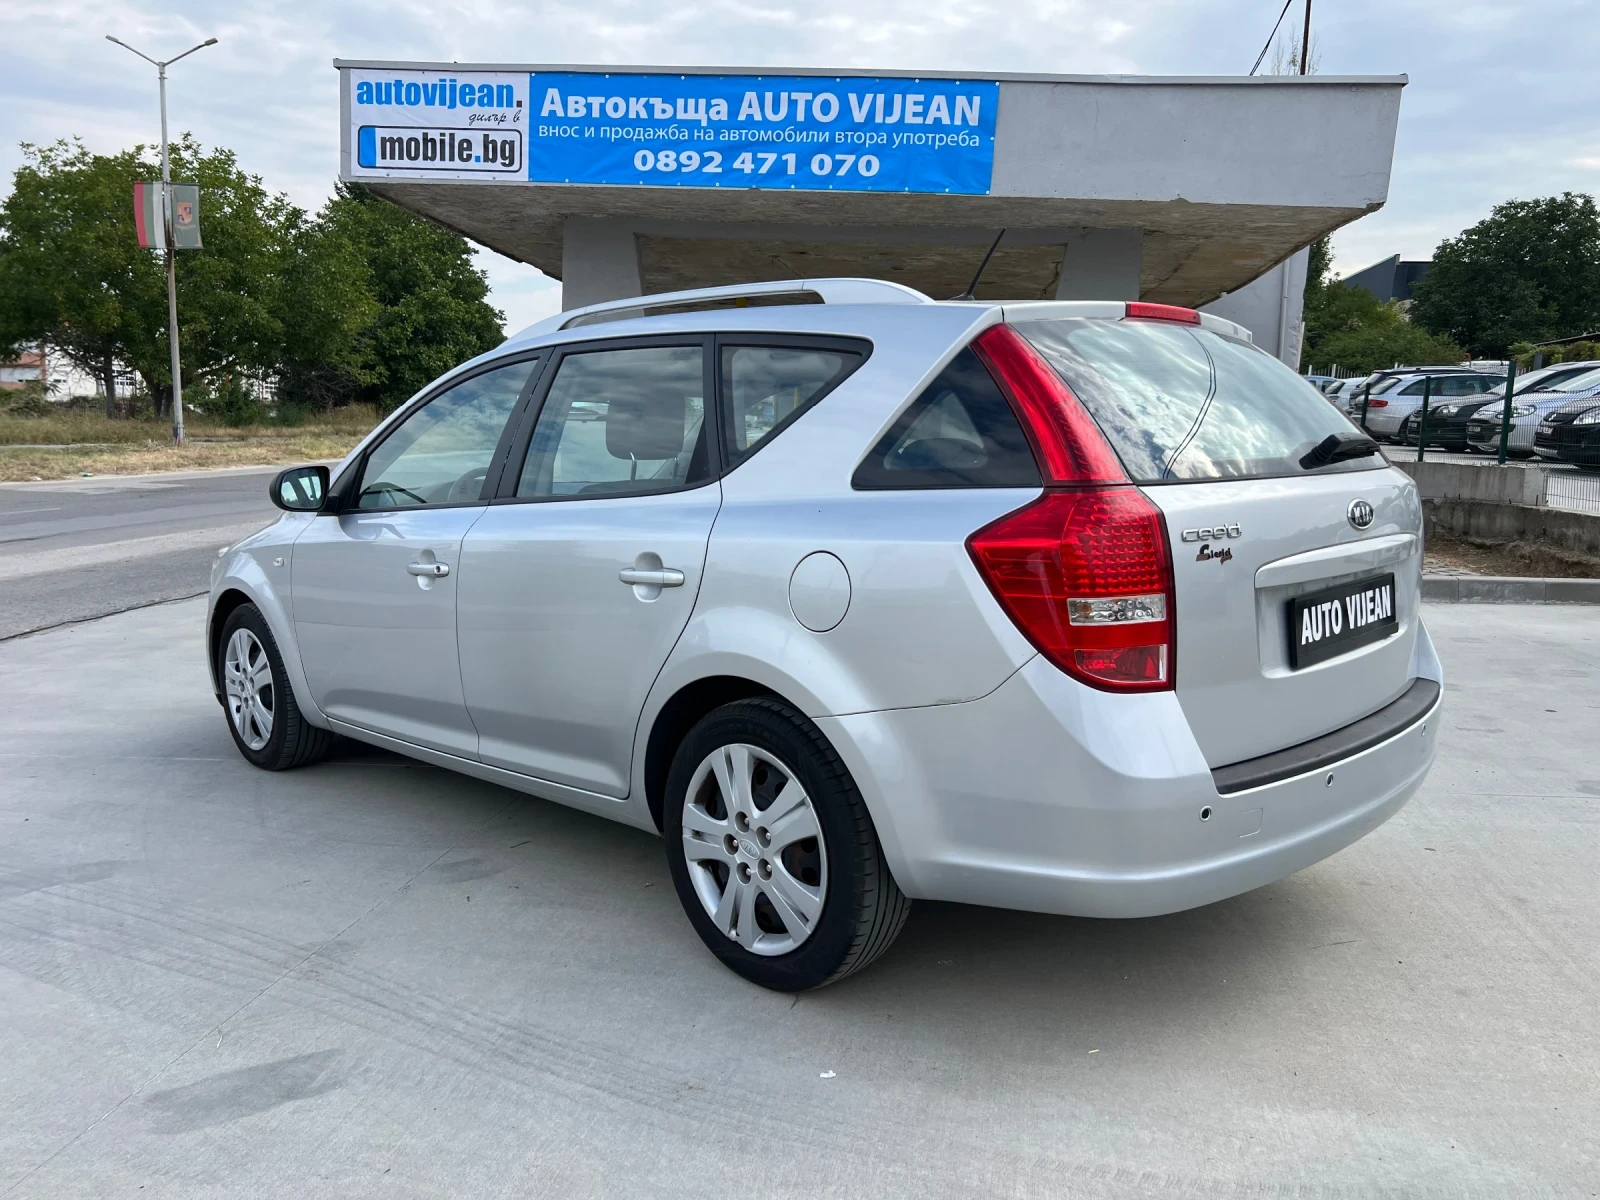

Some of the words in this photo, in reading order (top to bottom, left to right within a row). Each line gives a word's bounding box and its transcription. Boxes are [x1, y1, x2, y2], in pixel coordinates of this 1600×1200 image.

[540, 87, 728, 127] Автокъща
[737, 91, 840, 123] AUTO
[848, 93, 981, 126] VIJEAN
[380, 131, 516, 168] mobile.bg
[538, 124, 580, 138] внос
[584, 126, 596, 138] и
[600, 123, 689, 142] продажба
[693, 128, 715, 141] на
[719, 125, 829, 143] автомобили
[834, 130, 888, 148] втора
[891, 130, 980, 150] употреба
[633, 149, 723, 173] 0892
[732, 151, 797, 175] 471
[810, 153, 880, 177] 070
[1301, 599, 1342, 645] AUTO
[1345, 584, 1392, 630] VIJEAN
